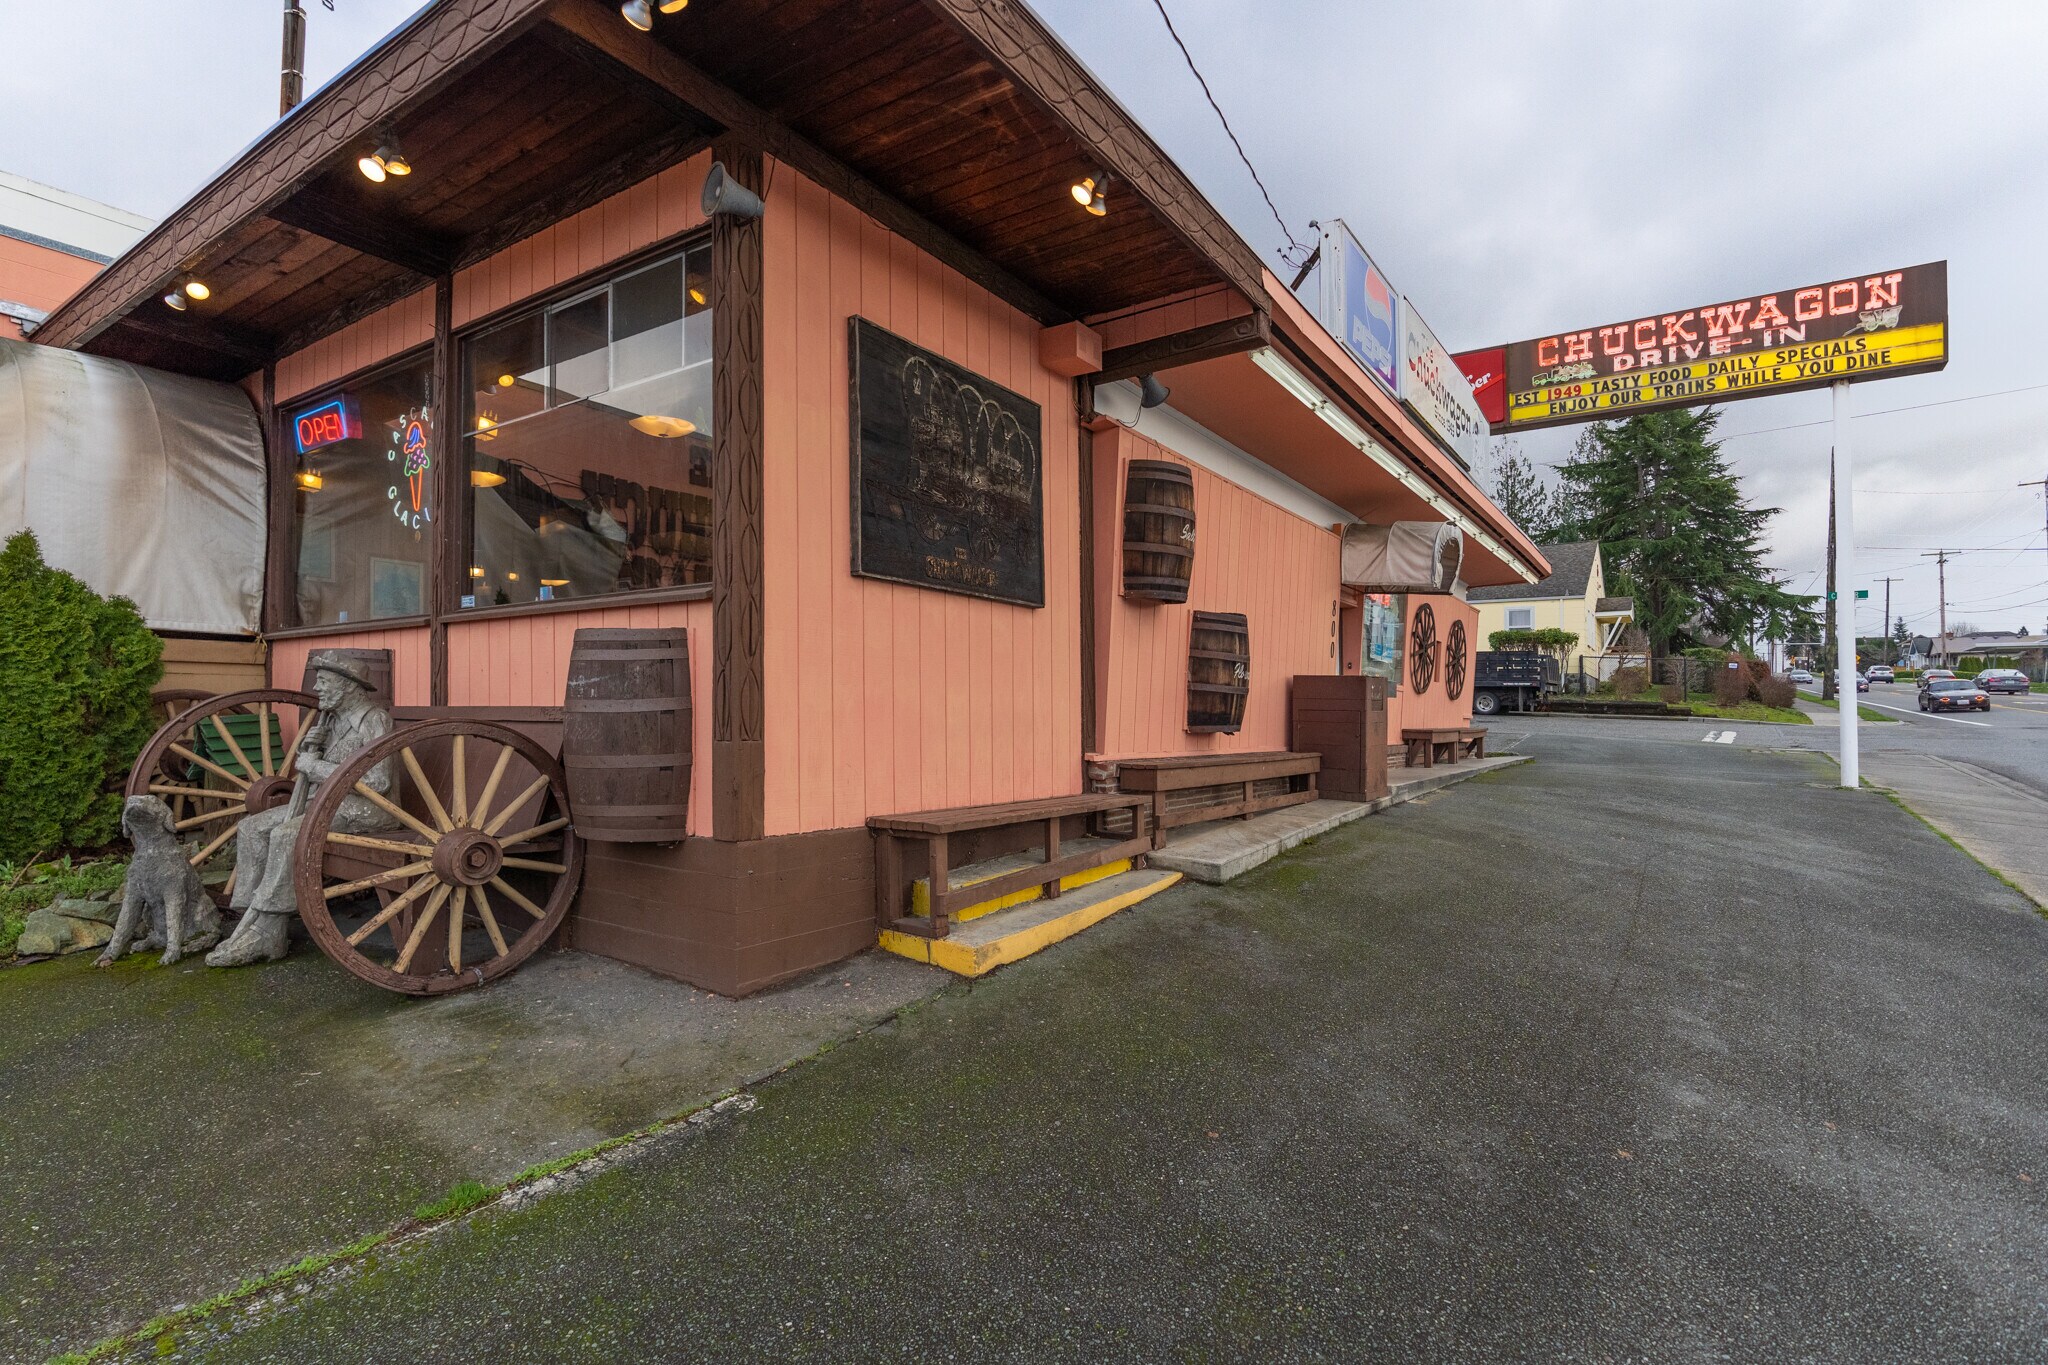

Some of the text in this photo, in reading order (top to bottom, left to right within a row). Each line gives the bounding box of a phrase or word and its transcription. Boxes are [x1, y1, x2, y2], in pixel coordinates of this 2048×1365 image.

[1353, 314, 1392, 379] PEPSI
[1538, 272, 1903, 367] CHUCKWAGON
[1613, 323, 1806, 372] DRIVE-IN
[1515, 338, 1867, 407] EST 1949 TASTY FOOD DAILY SPECIALS
[1550, 350, 1891, 415] ENJOY OUR TRAINS WHILE YOU DINE
[300, 413, 345, 446] OPEN
